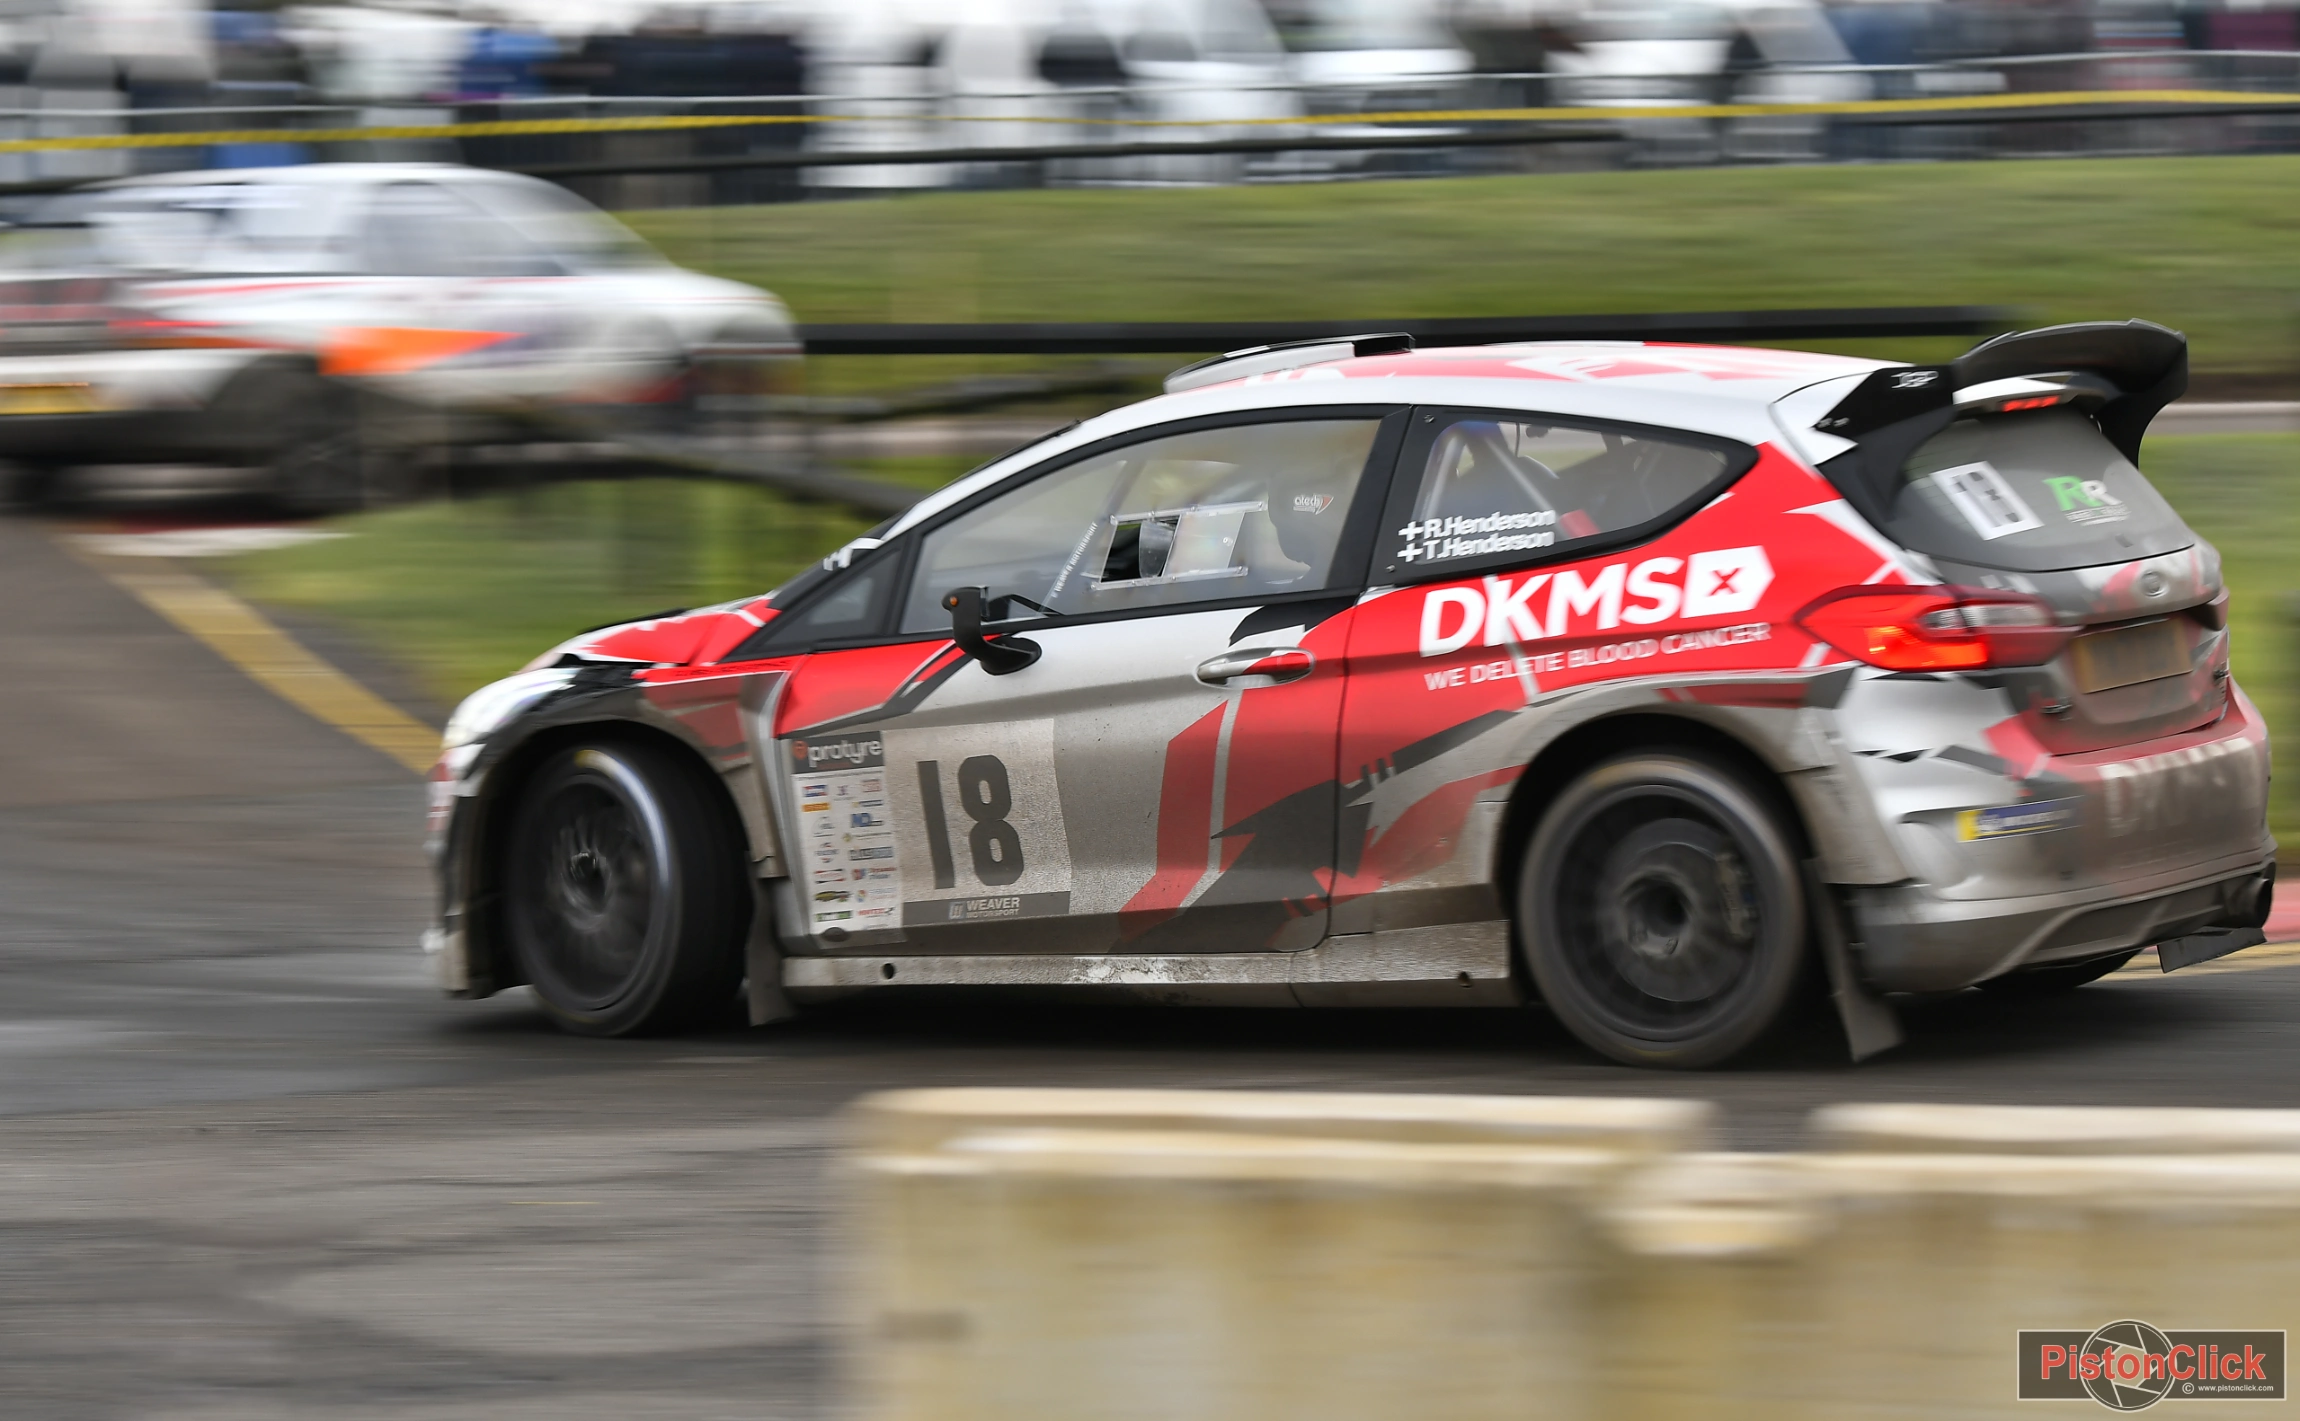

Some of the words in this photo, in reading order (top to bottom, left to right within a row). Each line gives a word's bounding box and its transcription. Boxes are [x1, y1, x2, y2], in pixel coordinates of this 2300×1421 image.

[1419, 556, 1688, 657] DKMS
[1424, 667, 1466, 691] WE
[1470, 651, 1564, 685] DELETE
[1567, 638, 1660, 668] BLOOD
[1660, 622, 1773, 656] CANCER
[807, 739, 882, 768] protyre
[917, 754, 1024, 890] 18
[966, 897, 1021, 912] WEAVER
[966, 908, 1020, 919] MOTORSPORT
